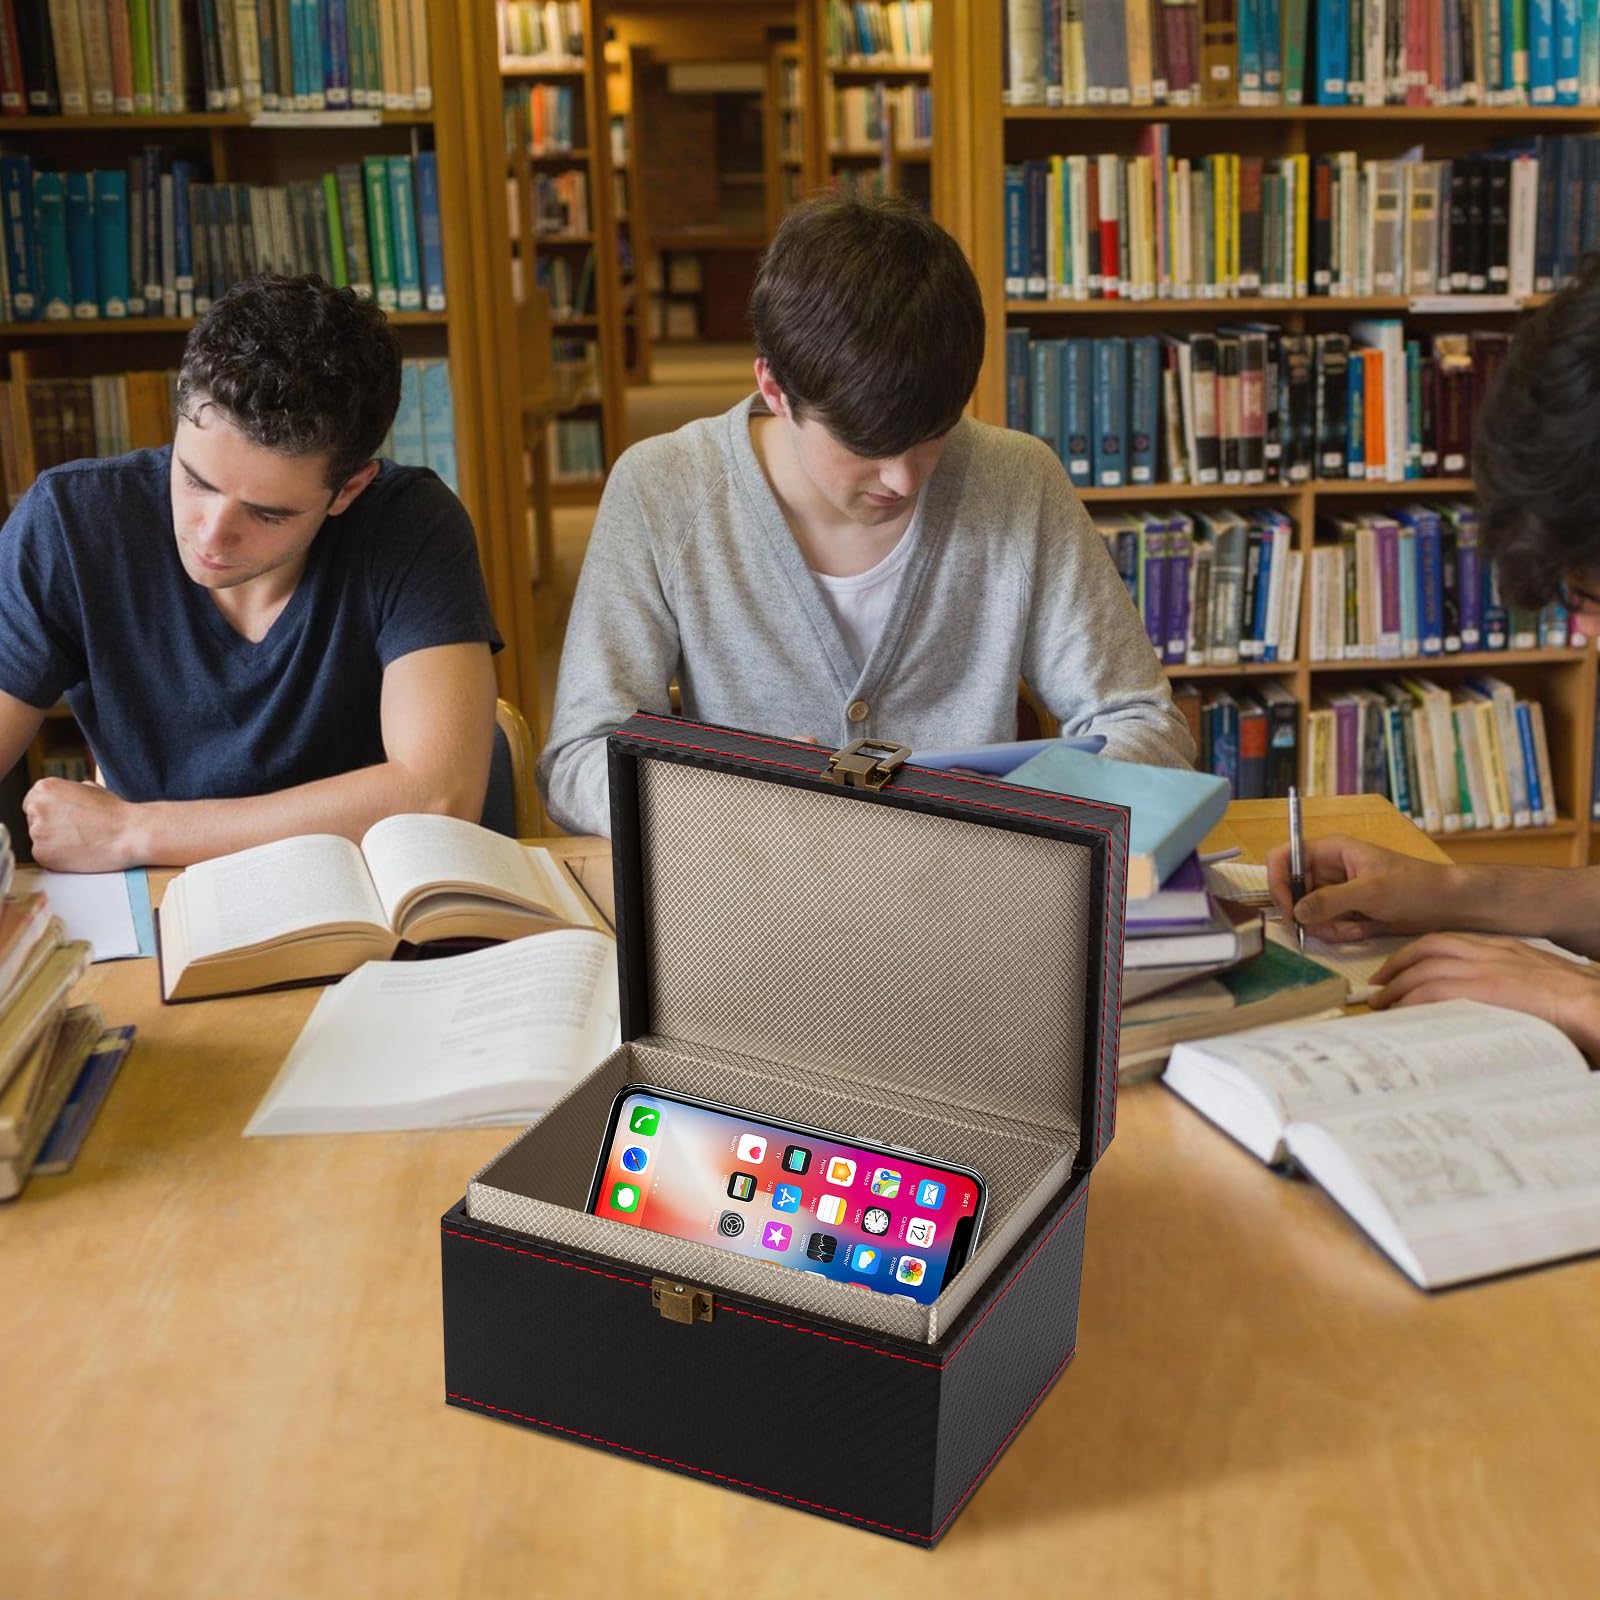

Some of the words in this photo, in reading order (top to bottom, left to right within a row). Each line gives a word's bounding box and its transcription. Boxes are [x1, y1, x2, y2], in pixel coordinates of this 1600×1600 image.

[776, 1152, 782, 1160] TV
[962, 1193, 970, 1208] 9:41
[910, 1224, 926, 1241] 12
